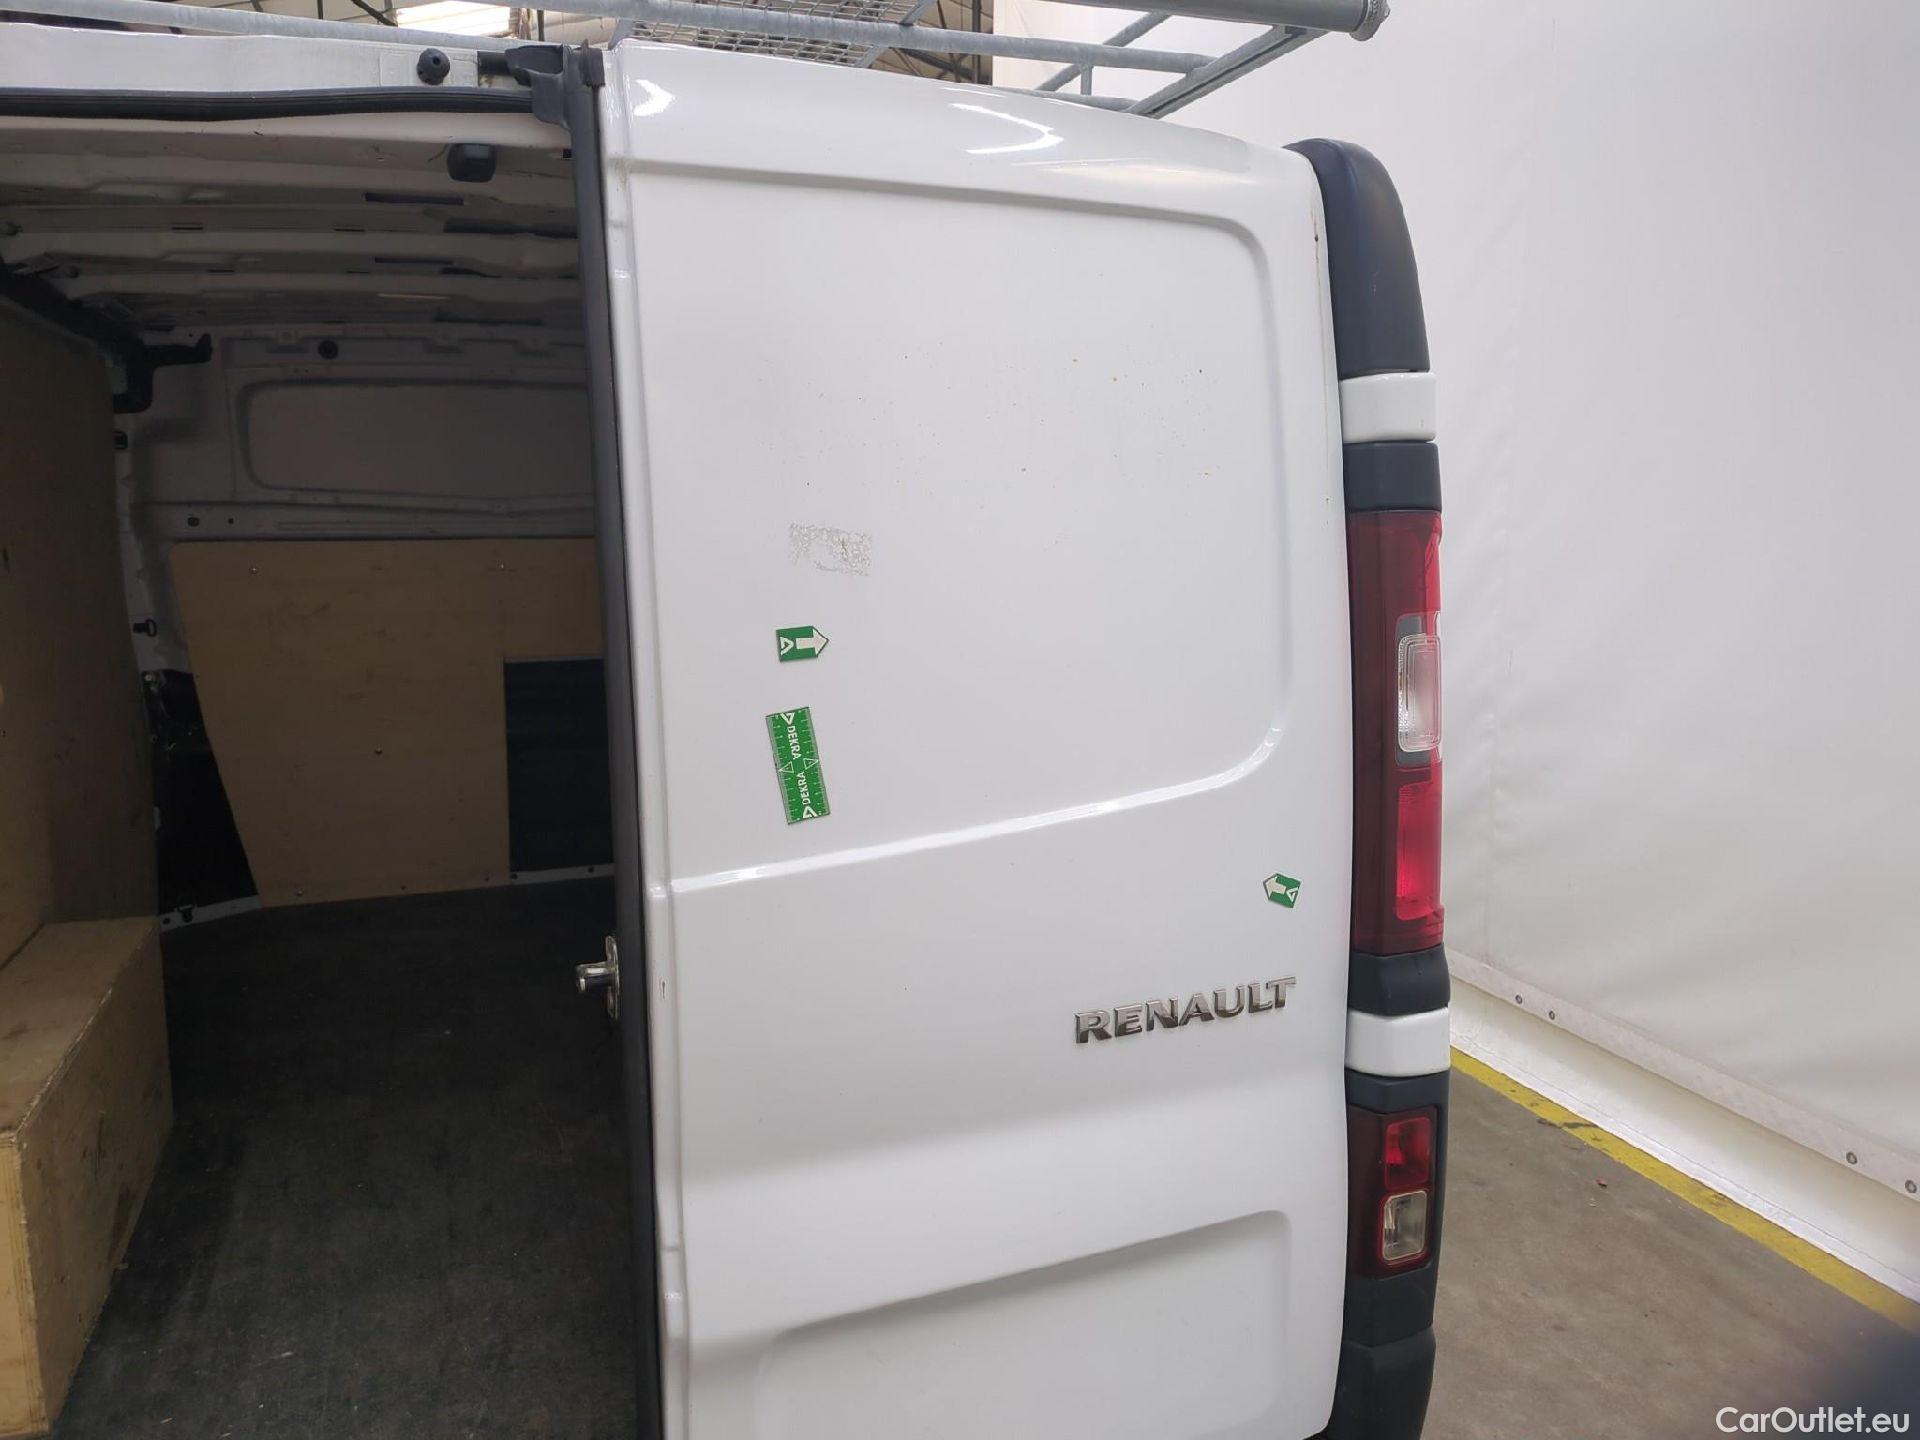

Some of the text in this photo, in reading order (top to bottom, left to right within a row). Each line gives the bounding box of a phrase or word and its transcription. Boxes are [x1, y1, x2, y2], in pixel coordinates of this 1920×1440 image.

[786, 725, 802, 760] DEKRA
[796, 771, 811, 805] DEKRA
[1075, 976, 1297, 1043] RENAULT
